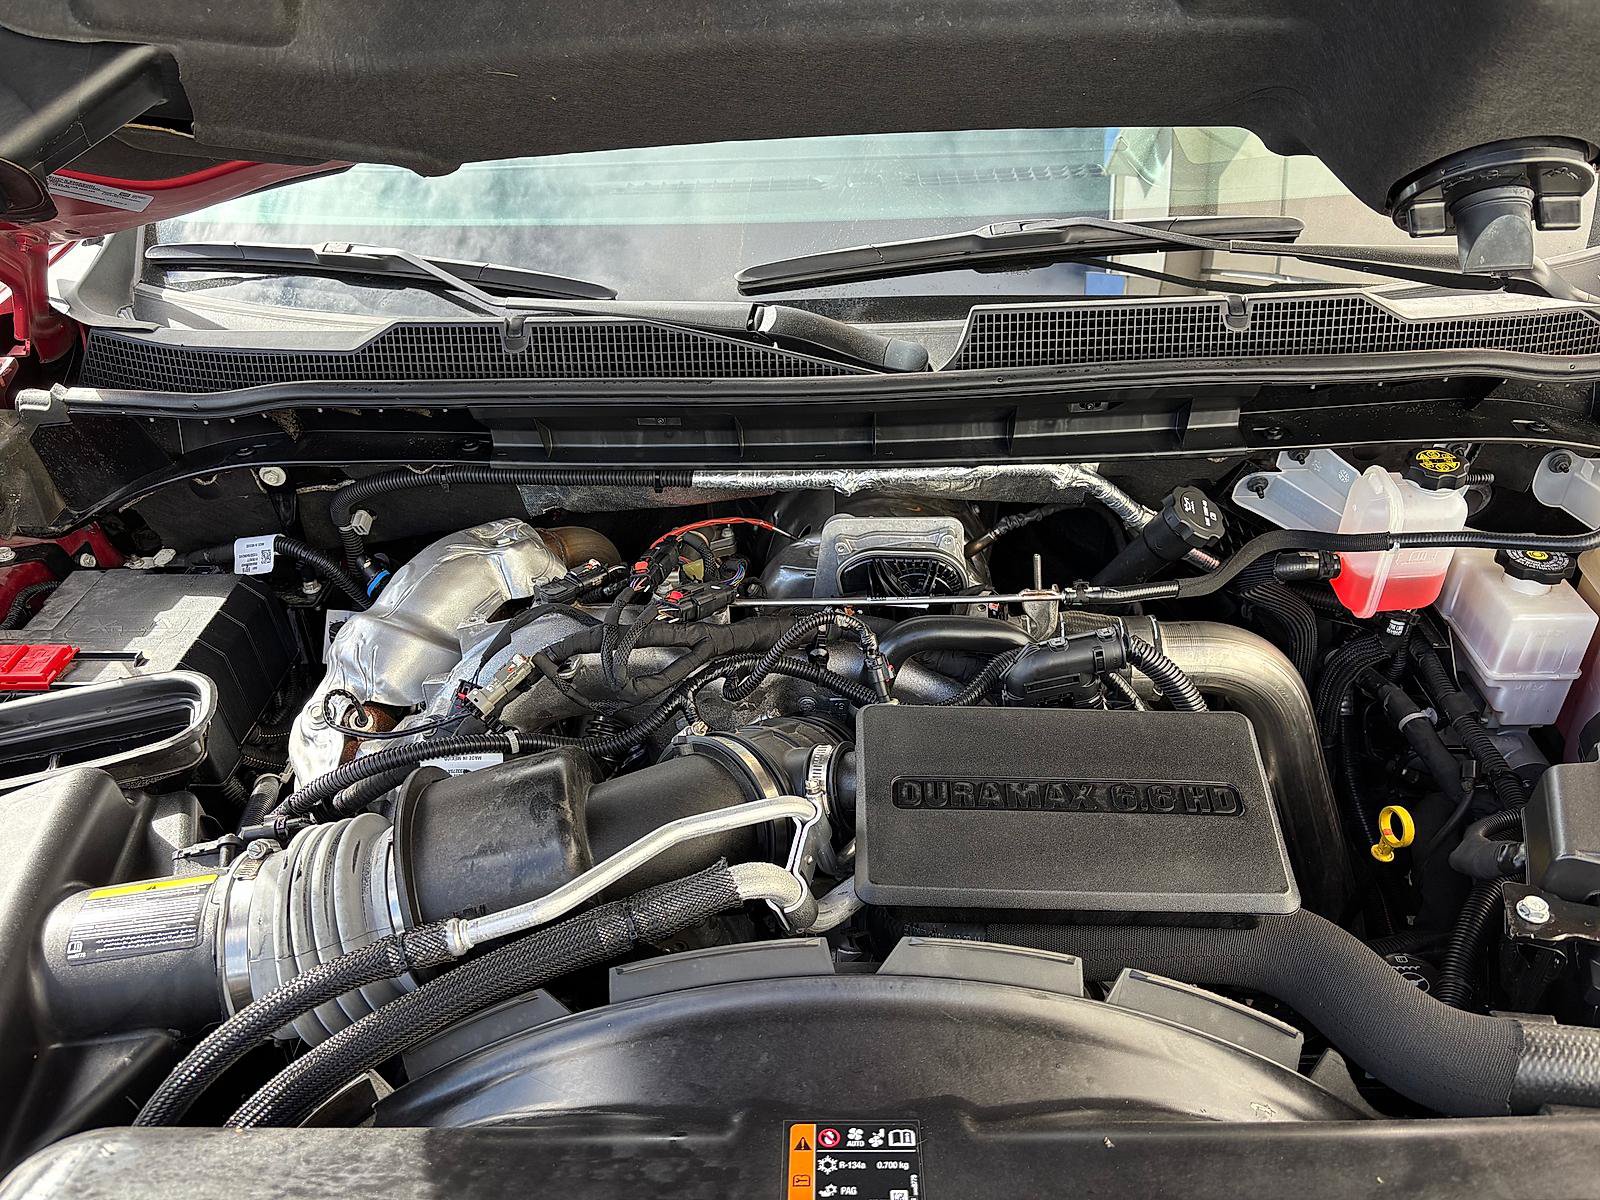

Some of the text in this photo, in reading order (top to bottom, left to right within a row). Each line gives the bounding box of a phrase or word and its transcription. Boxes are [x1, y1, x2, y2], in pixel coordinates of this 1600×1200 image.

[898, 781, 1098, 811] DURAMAX
[1182, 785, 1238, 814] HD
[838, 1160, 910, 1171] R-134a 0.700 kg
[840, 1186, 858, 1195] PAG
